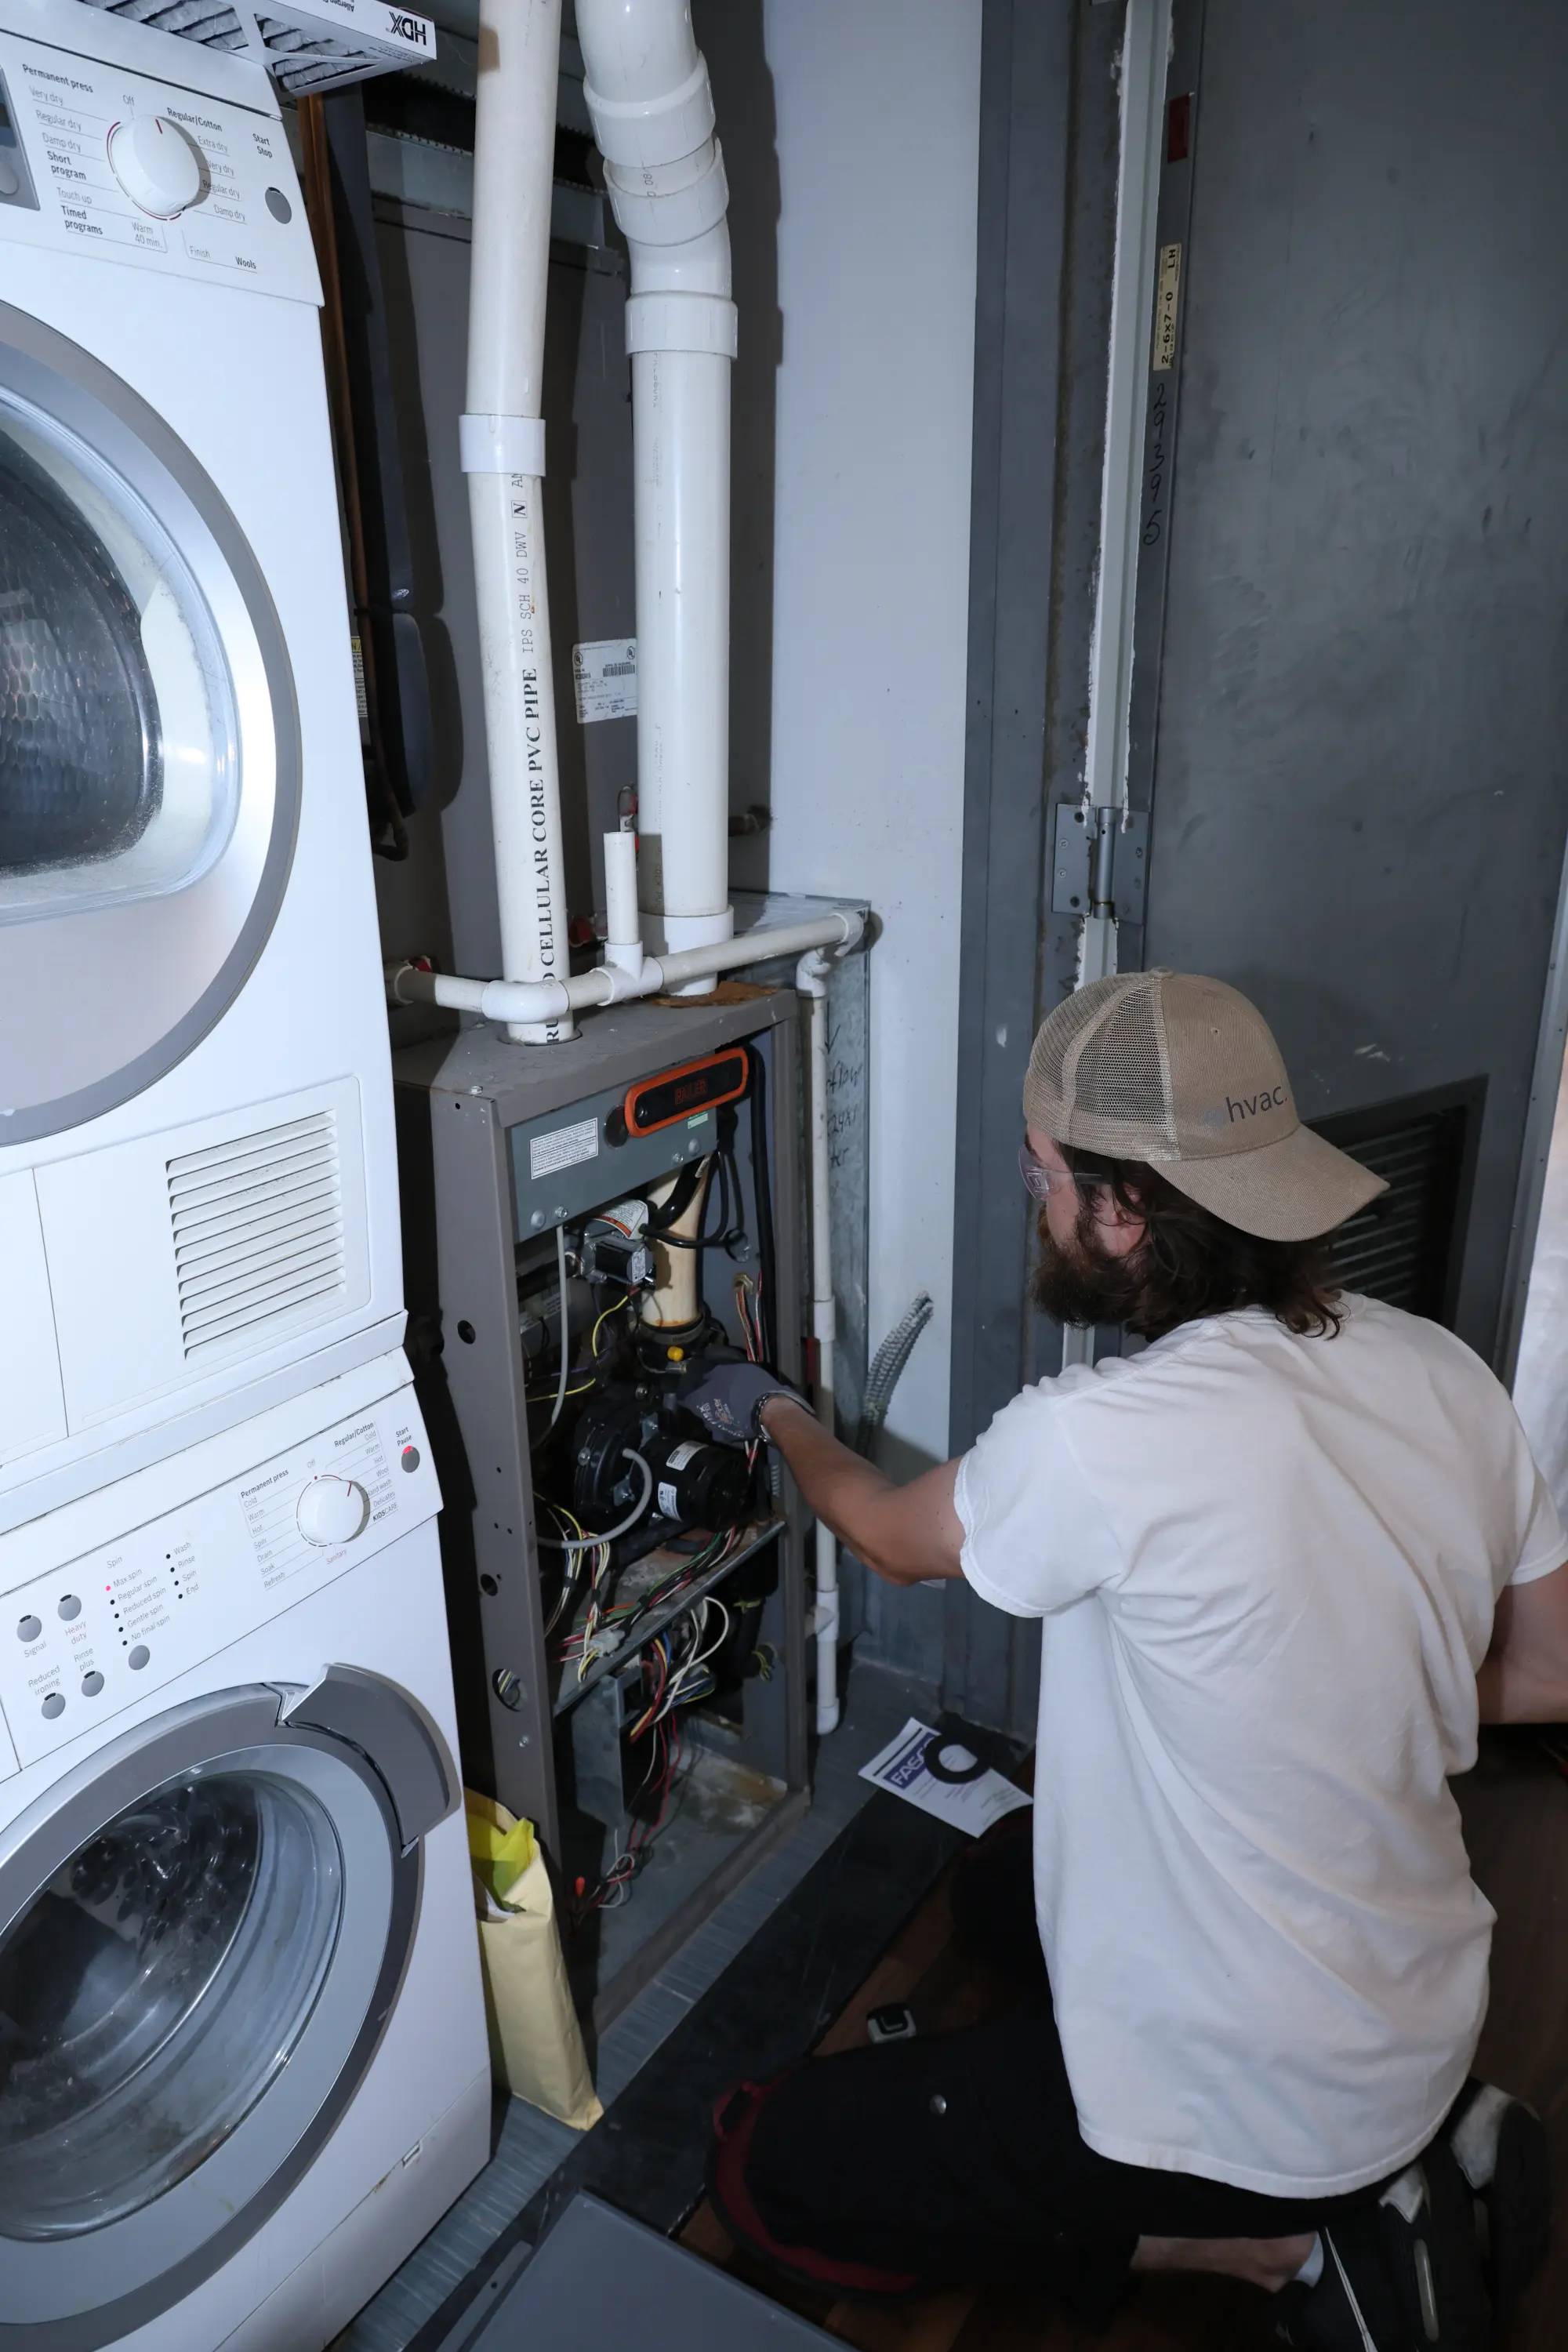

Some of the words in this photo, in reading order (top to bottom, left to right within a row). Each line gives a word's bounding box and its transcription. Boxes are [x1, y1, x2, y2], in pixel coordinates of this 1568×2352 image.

[22, 64, 69, 85] Permanent
[71, 80, 93, 93] press
[29, 86, 48, 101] Very
[49, 93, 64, 106] dry
[122, 95, 135, 106] Off
[36, 109, 66, 126] Regular
[67, 118, 82, 132] dry
[167, 107, 223, 132] Regular/Cotton
[42, 132, 66, 149] Damp
[67, 140, 81, 153] dry
[198, 136, 216, 148] Extra
[217, 143, 227, 153] dry
[252, 133, 270, 146] Start
[47, 151, 71, 165] Short
[256, 146, 273, 158] Stop
[51, 165, 86, 180] program
[207, 161, 222, 173] Very
[223, 166, 234, 176] dry
[56, 187, 78, 200] Touch
[82, 195, 92, 204] up
[202, 180, 227, 195] Regular
[228, 188, 240, 199] dry
[60, 205, 87, 220] Timed
[214, 205, 234, 217] Damp
[234, 211, 245, 221] dry
[65, 220, 103, 234] programs
[132, 221, 153, 234] Warm
[135, 234, 145, 244] 40
[147, 238, 163, 248] min.
[190, 246, 210, 259] Finish
[1167, 249, 1176, 269] LH
[235, 256, 256, 269] Wools
[516, 532, 528, 557] DWV
[517, 568, 528, 584] 40
[520, 594, 532, 620] SCH
[522, 630, 534, 654] IPS
[522, 668, 539, 719] PIPE
[526, 728, 543, 771] PVC
[530, 779, 546, 843] CORE
[534, 848, 554, 967] CELLULAR
[335, 1421, 374, 1447] Regular/Cotton
[365, 1431, 376, 1441] Cold
[396, 1427, 409, 1438] Start
[397, 1435, 412, 1446] Pause
[365, 1443, 380, 1455] Warm
[307, 1459, 316, 1469] Off
[374, 1455, 383, 1465] Hot
[376, 1467, 389, 1478] Wool
[241, 1478, 272, 1498] Permanent
[273, 1468, 289, 1483] press
[366, 1485, 379, 1497] Hand
[379, 1479, 392, 1490] wash
[244, 1497, 257, 1508] Cold
[373, 1491, 395, 1508] Delicates
[248, 1508, 265, 1522] Warm
[372, 1502, 398, 1523] KIDSCARE
[252, 1525, 263, 1535] Hot
[173, 1541, 191, 1555] Wash
[253, 1538, 267, 1550] Spin
[107, 1556, 123, 1570] Spin
[178, 1555, 195, 1569] Rinse
[257, 1549, 273, 1563] Drain
[326, 1548, 347, 1565] Sanitary
[182, 1570, 197, 1582] Spin
[261, 1563, 275, 1575] Soak
[113, 1578, 127, 1588] Max
[129, 1568, 143, 1581] spin
[263, 1571, 285, 1588] Refresh
[118, 1584, 143, 1602] Regular
[143, 1576, 158, 1588] spin
[186, 1583, 199, 1595] End
[123, 1593, 152, 1615] Reduced
[152, 1587, 167, 1601] spin
[127, 1611, 149, 1628] Gentle
[150, 1603, 164, 1617] spin
[64, 1621, 86, 1636] Heavy
[131, 1632, 141, 1642] No
[141, 1622, 156, 1635] final
[156, 1614, 171, 1628] spin
[71, 1632, 87, 1645] duty
[24, 1640, 47, 1658] Signal
[74, 1647, 93, 1662] Rinse
[79, 1658, 94, 1671] plus
[28, 1665, 60, 1687] Reduced
[34, 1679, 60, 1696] ironing
[891, 1737, 935, 1785] FASC
